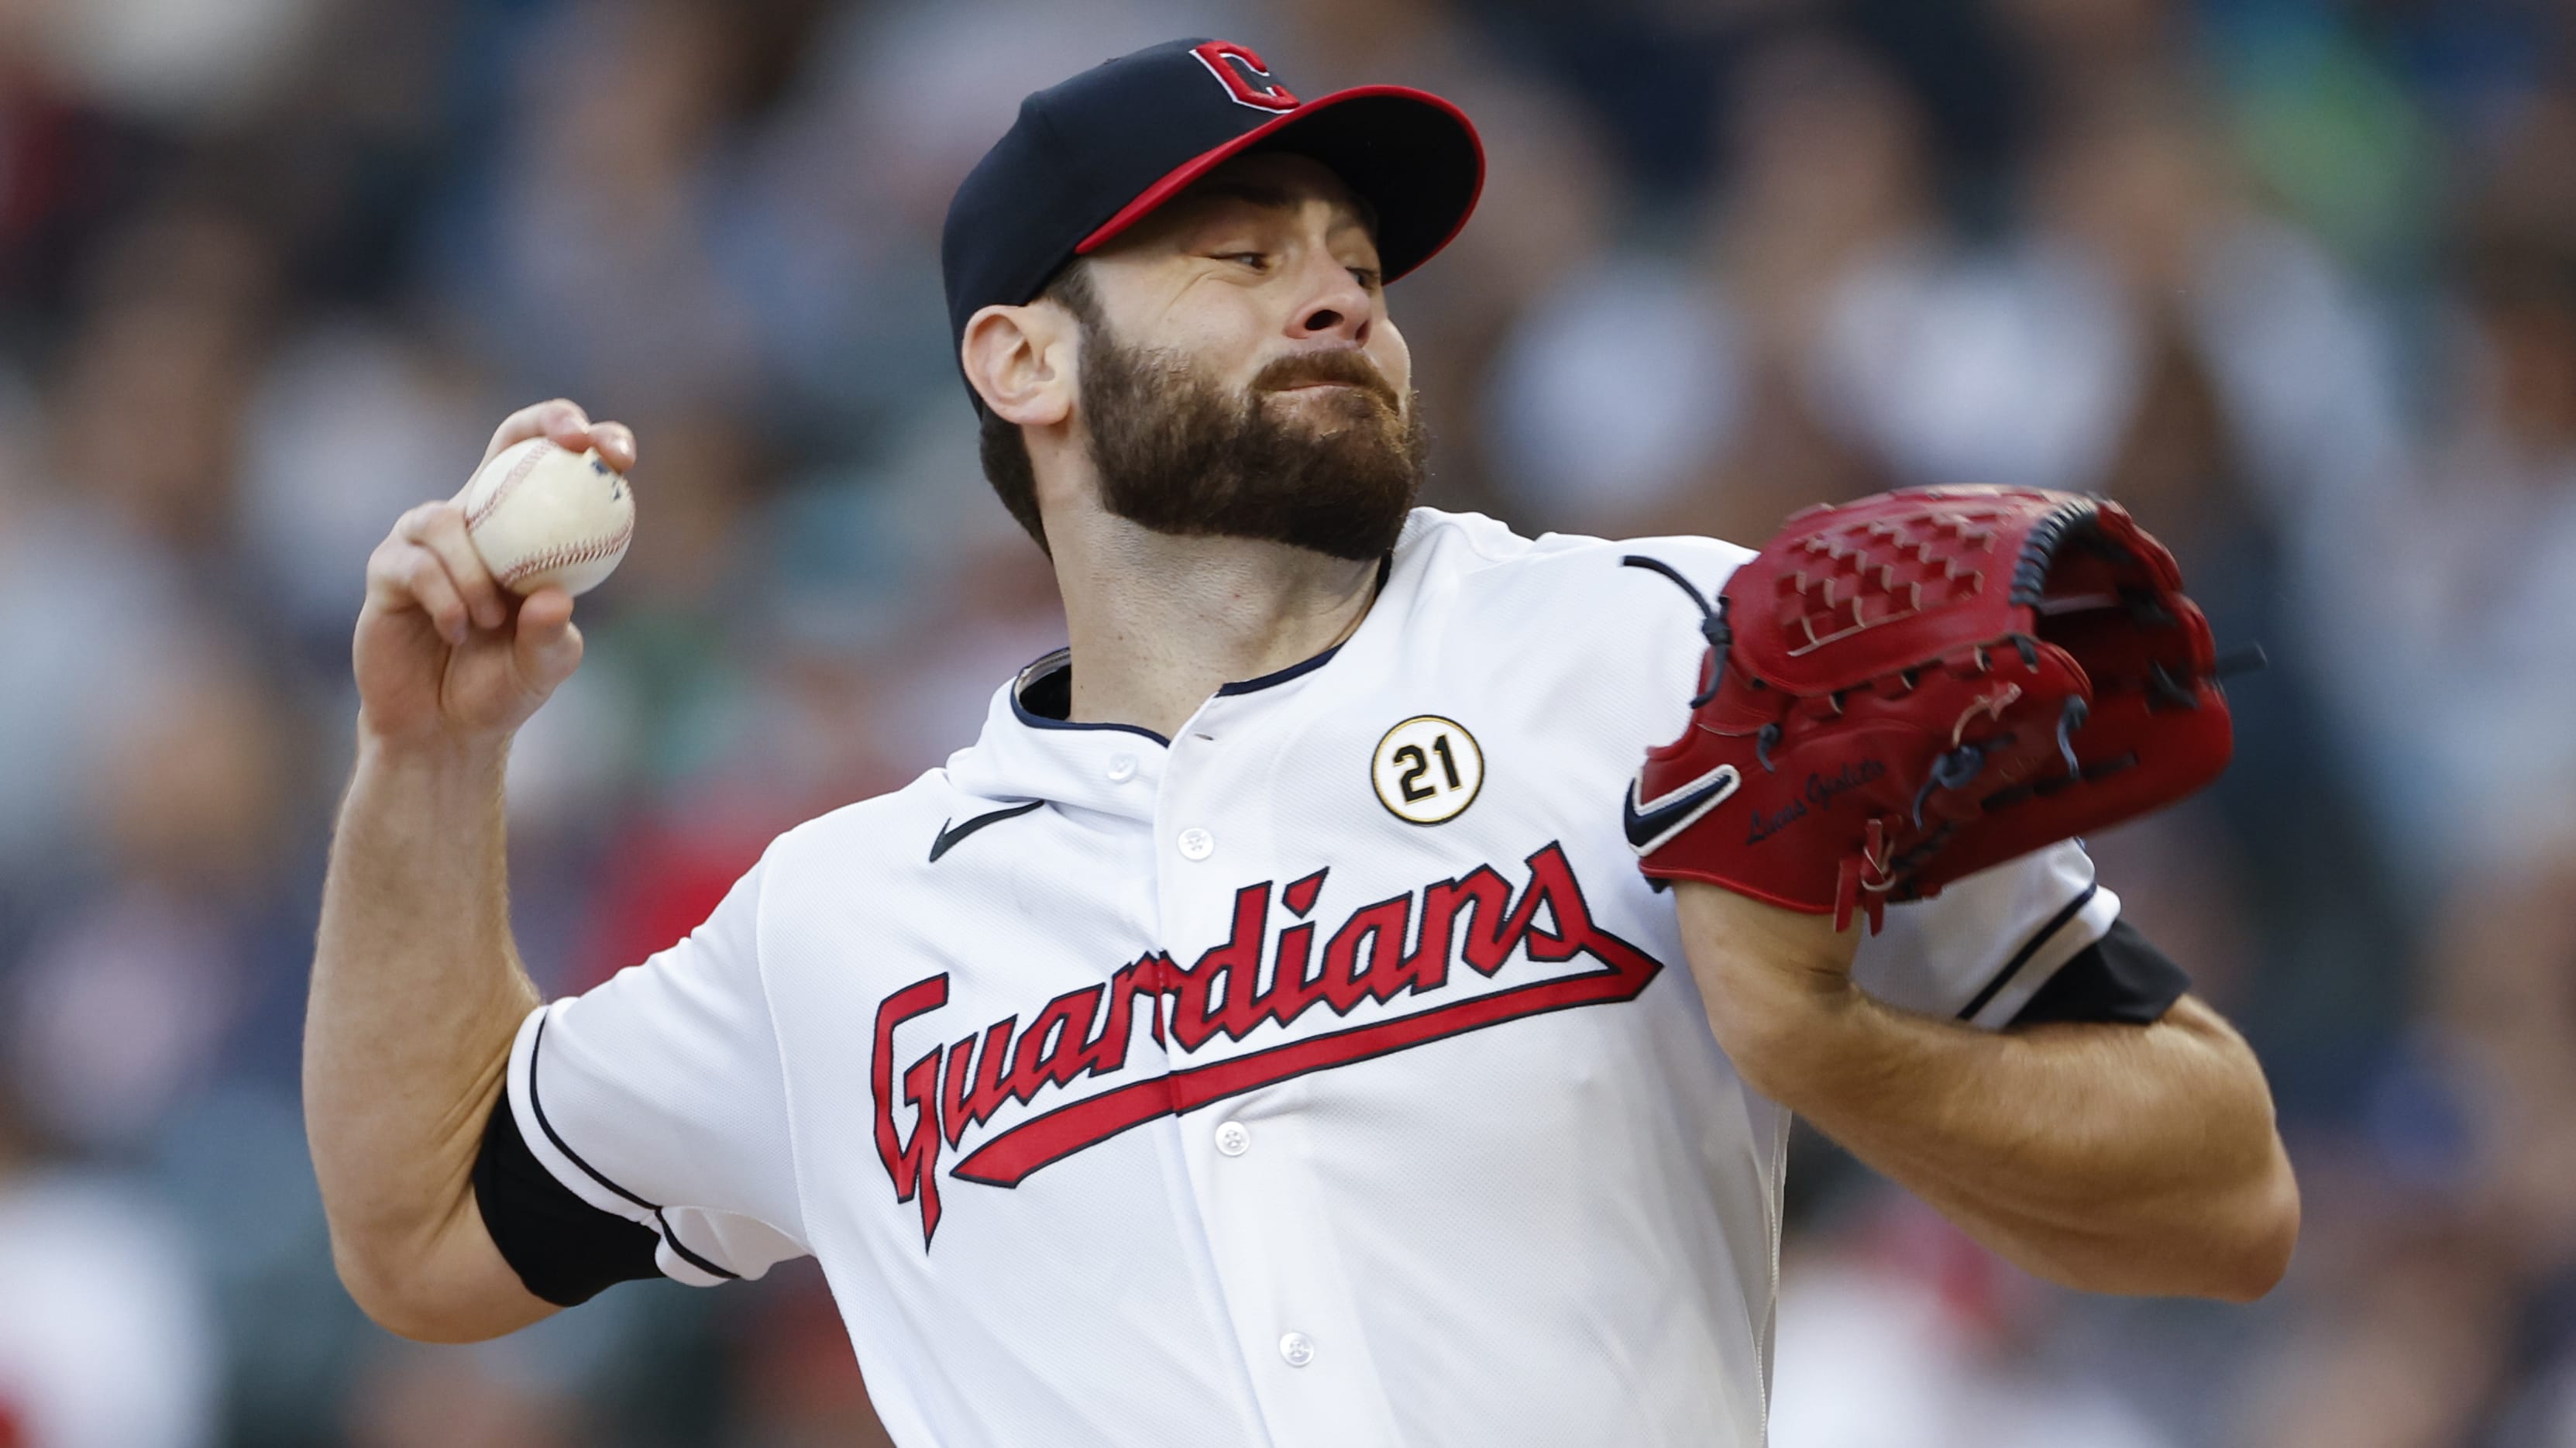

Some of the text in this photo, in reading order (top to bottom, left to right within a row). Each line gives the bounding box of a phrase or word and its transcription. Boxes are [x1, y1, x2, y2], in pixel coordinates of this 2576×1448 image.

[1188, 40, 1302, 113] C
[1392, 733, 1463, 806] 21
[871, 841, 1663, 1255] Guardians
